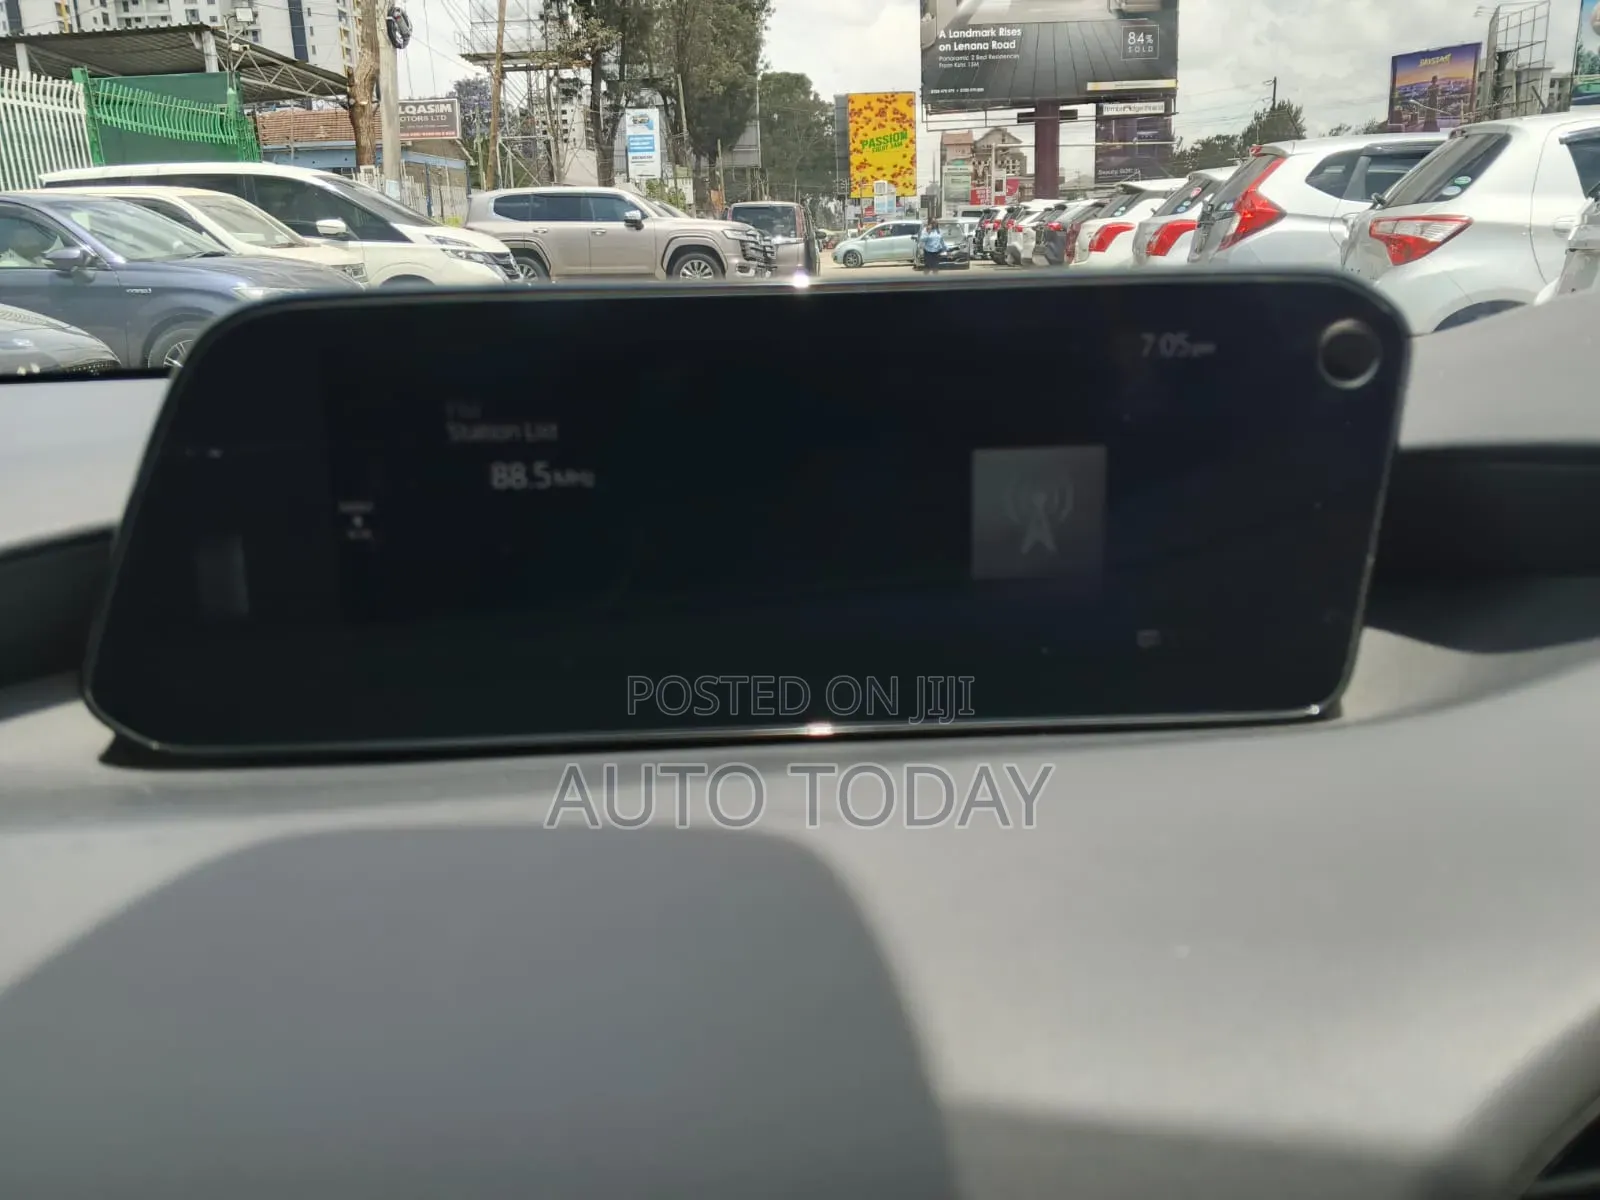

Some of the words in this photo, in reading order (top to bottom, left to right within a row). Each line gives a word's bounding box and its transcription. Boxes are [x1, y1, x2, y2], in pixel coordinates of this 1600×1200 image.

[938, 29, 946, 39] A
[948, 28, 997, 39] Landmark
[998, 26, 1022, 37] Rises
[1127, 31, 1154, 45] 84%
[938, 42, 952, 52] on
[953, 41, 989, 51] Lenana
[991, 39, 1016, 49] Road
[1127, 45, 1154, 53] SOLD
[399, 103, 453, 115] LQASIM
[861, 131, 908, 150] PASSION
